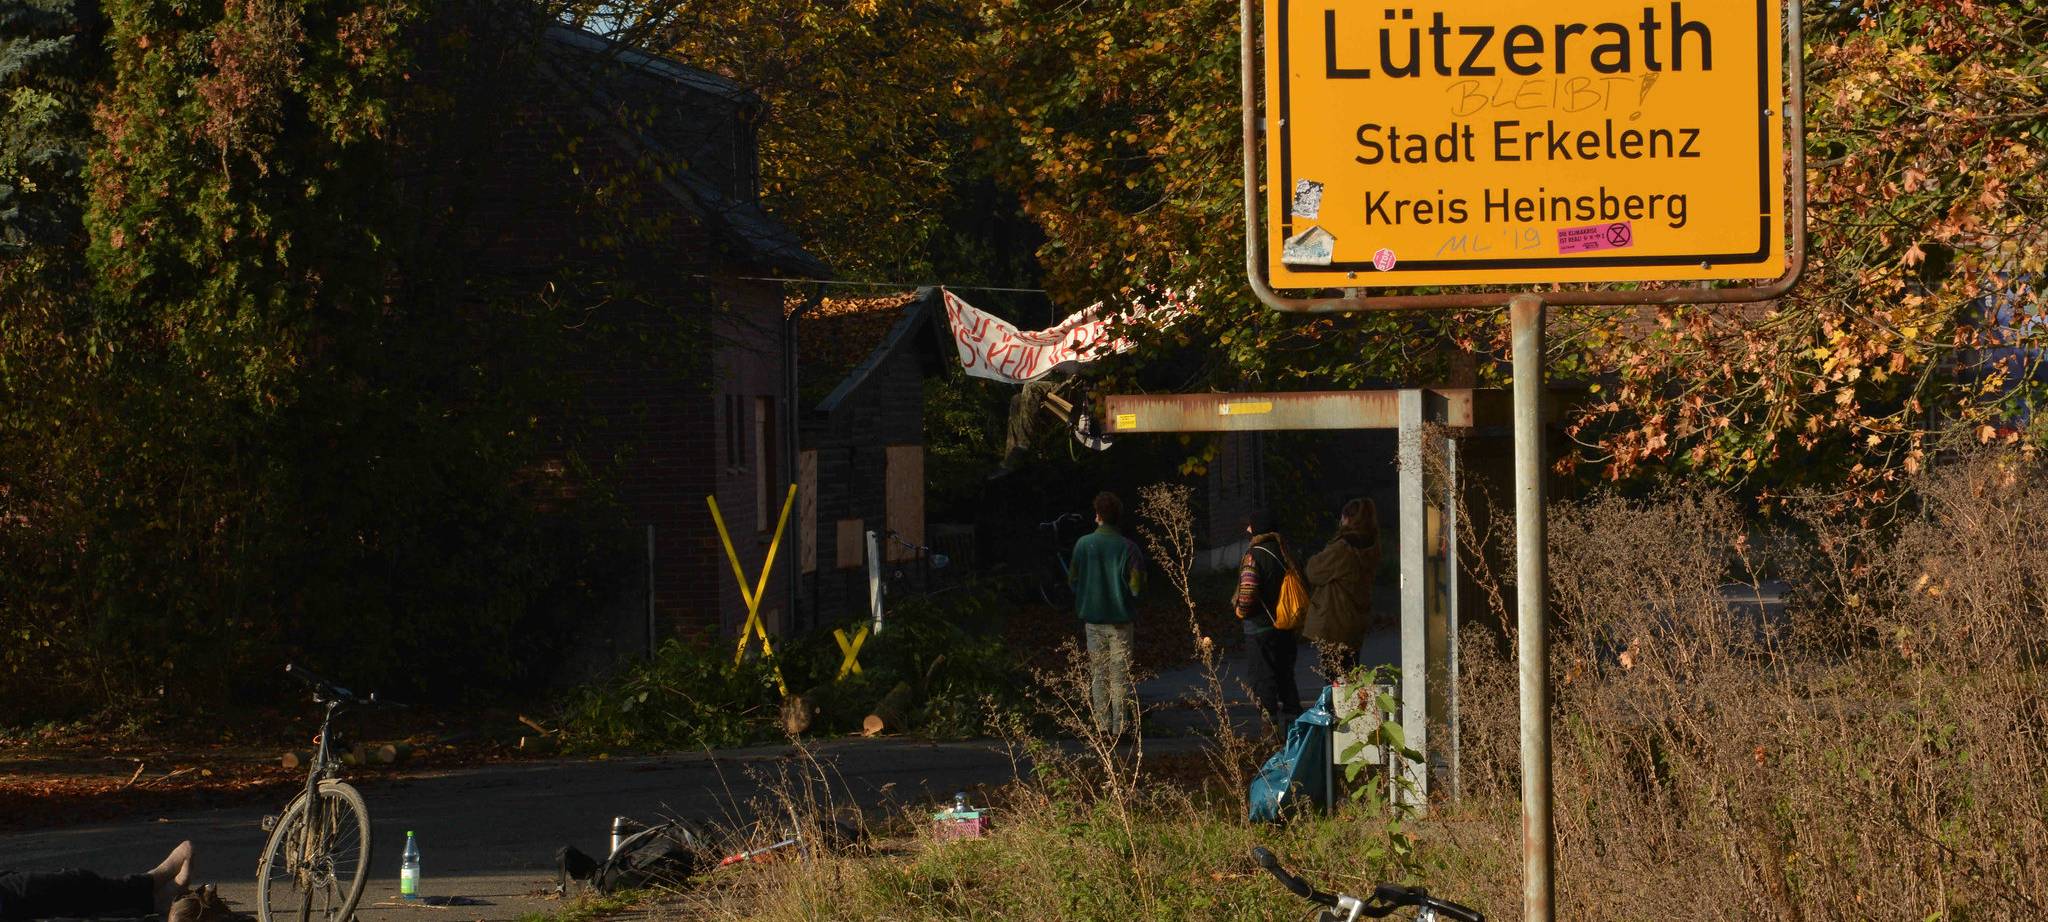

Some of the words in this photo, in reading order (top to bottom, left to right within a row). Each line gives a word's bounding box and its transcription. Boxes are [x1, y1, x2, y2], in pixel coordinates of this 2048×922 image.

[1325, 2, 1711, 78] Lützerath
[1356, 123, 1474, 164] Stadt
[1495, 119, 1700, 162] Erkelenz
[1366, 190, 1467, 224] Kreis
[1485, 187, 1686, 229] Heinsberg
[986, 342, 1043, 380] KEIN
